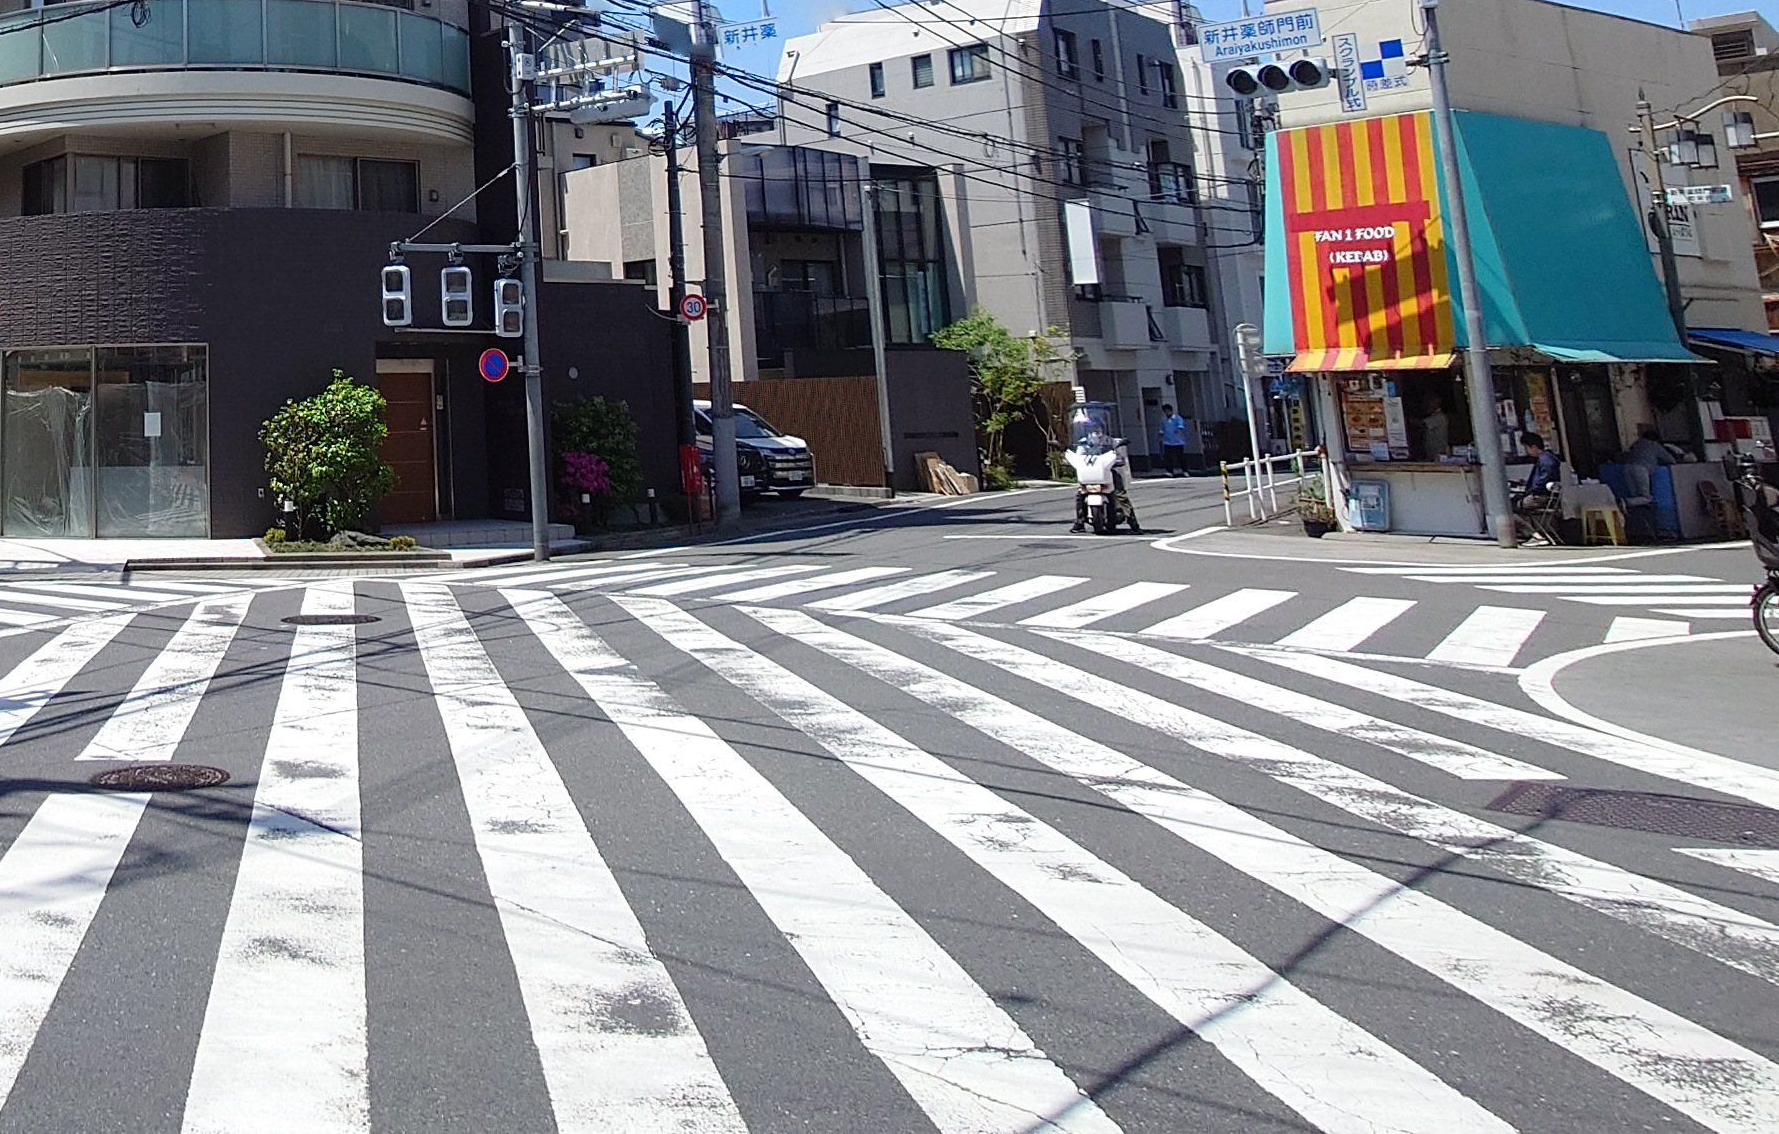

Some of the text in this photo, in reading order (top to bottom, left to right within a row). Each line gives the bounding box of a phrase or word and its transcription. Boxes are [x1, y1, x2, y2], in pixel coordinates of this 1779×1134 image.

[1204, 14, 1314, 46] 新井薬師門前
[1215, 34, 1308, 58] Araiyakushimon
[1338, 37, 1362, 111] スクランブル式
[1315, 226, 1395, 242] FAN 1 FOOD
[686, 301, 701, 313] 30
